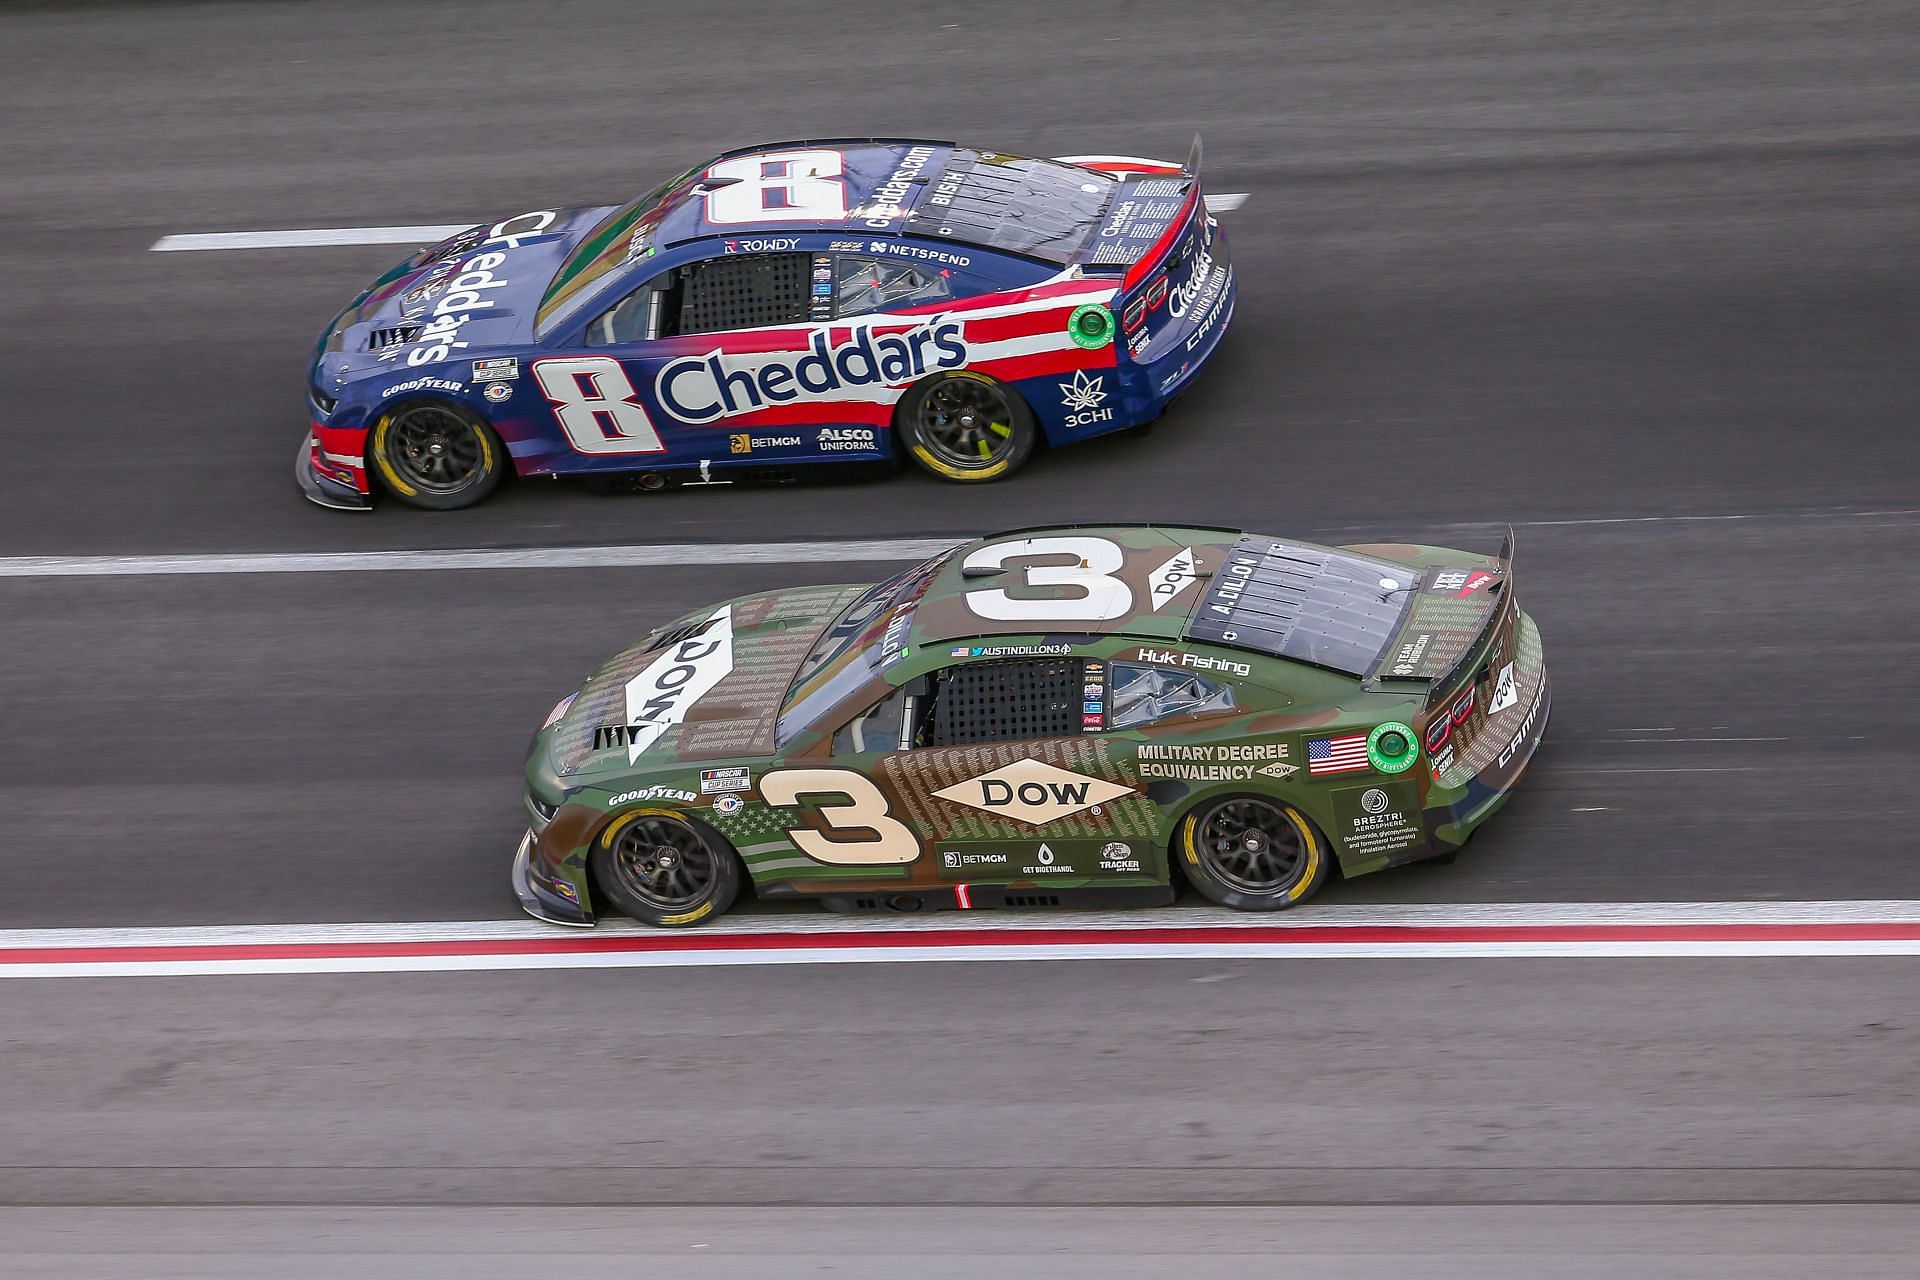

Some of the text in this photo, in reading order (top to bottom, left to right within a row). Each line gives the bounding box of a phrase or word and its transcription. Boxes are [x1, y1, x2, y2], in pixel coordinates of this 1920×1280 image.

[705, 151, 845, 225] 8
[739, 237, 801, 252] ROWDY
[889, 245, 970, 267] NETSPEND
[658, 316, 968, 422] Cheddar's
[382, 376, 463, 398] GOODYEAR
[532, 357, 667, 455] 8
[1064, 408, 1113, 427] 3CHI
[751, 436, 801, 448] BETMGM
[816, 428, 874, 441] ALSCO
[962, 537, 1134, 621] 3
[1154, 559, 1191, 596] DOW
[1398, 643, 1414, 662] TEAM
[1138, 648, 1251, 677] Huk Fishing
[1138, 744, 1289, 761] MILITARY DEGREE
[716, 769, 742, 778] NASCAR
[1139, 763, 1255, 780] EQUIVALENCY
[1266, 766, 1293, 775] DOW
[608, 785, 697, 806] GOODYEAR
[978, 779, 1091, 806] DOW
[759, 770, 922, 865] 3
[1353, 812, 1403, 827] BREZTRI
[1349, 841, 1360, 849] and
[963, 854, 1007, 864] BETMGM
[1100, 861, 1140, 869] TRACKER
[1022, 865, 1074, 874] GET BIOETHANOL
